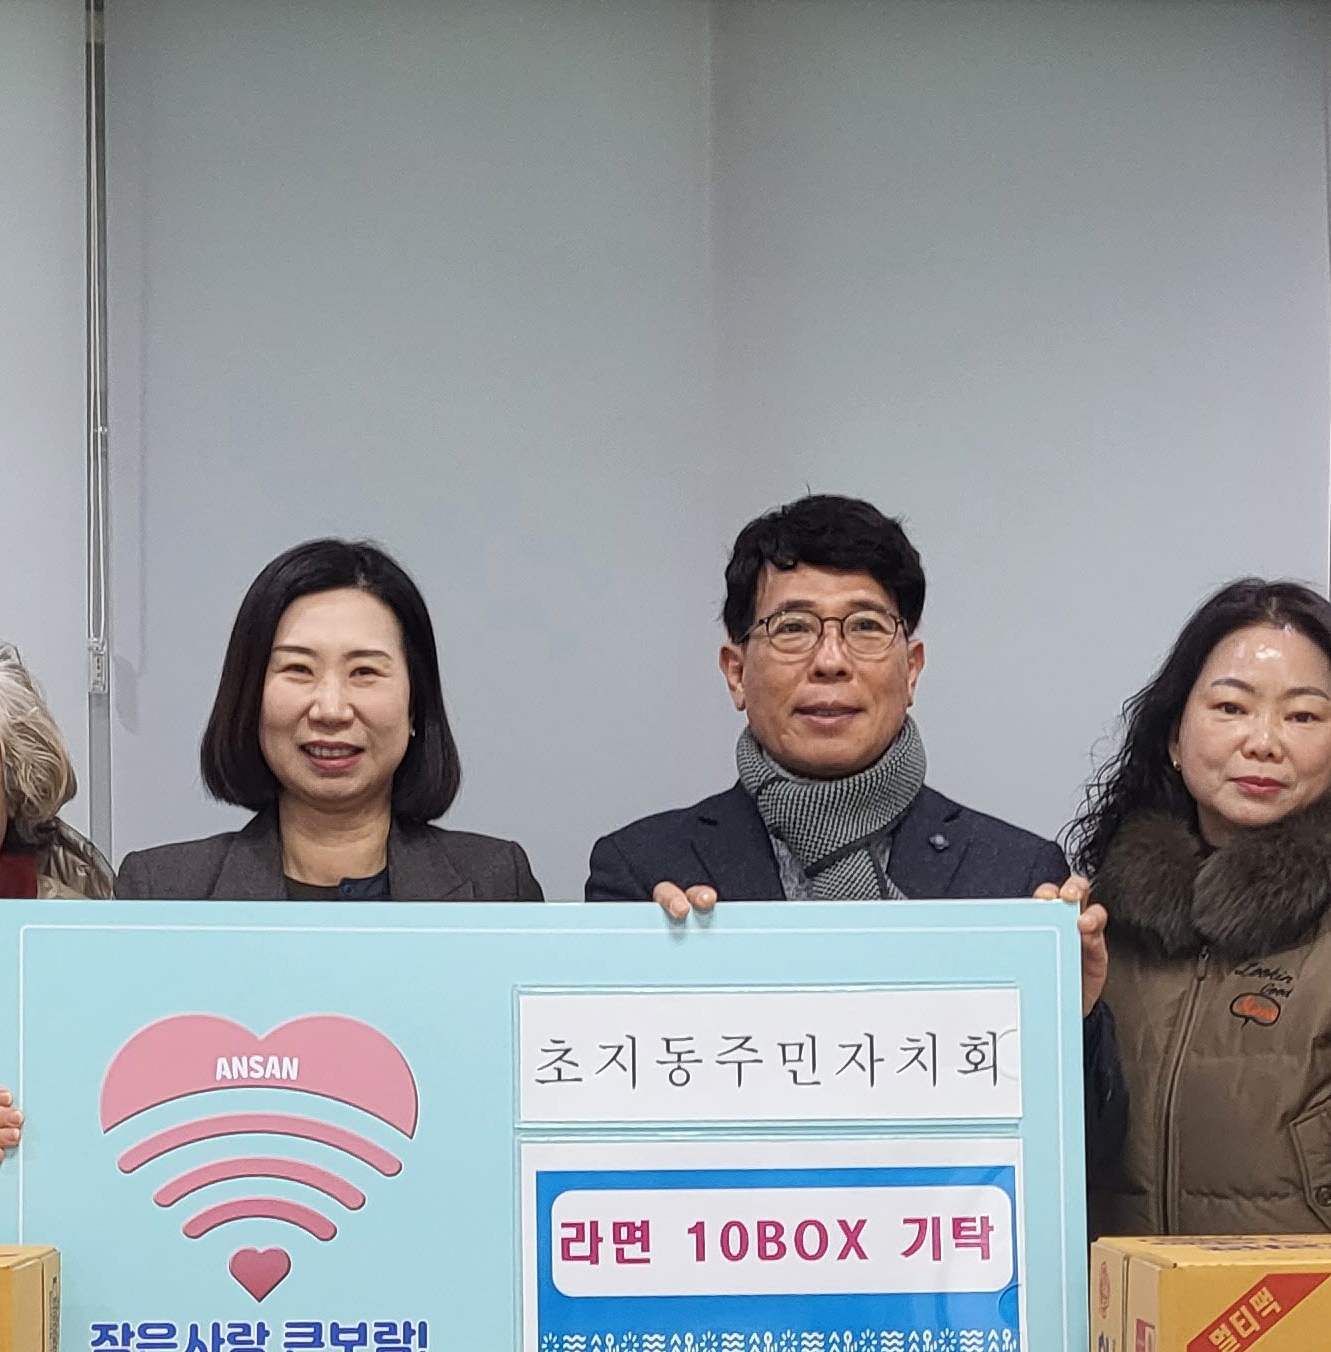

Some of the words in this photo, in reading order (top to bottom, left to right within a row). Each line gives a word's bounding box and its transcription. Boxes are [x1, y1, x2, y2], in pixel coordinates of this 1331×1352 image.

[214, 1054, 300, 1082] ANSAN
[533, 1029, 1004, 1091] 초지동주민자치회
[558, 1218, 655, 1268] 라면
[686, 1218, 869, 1263] 10BOX
[901, 1214, 995, 1263] 기탁
